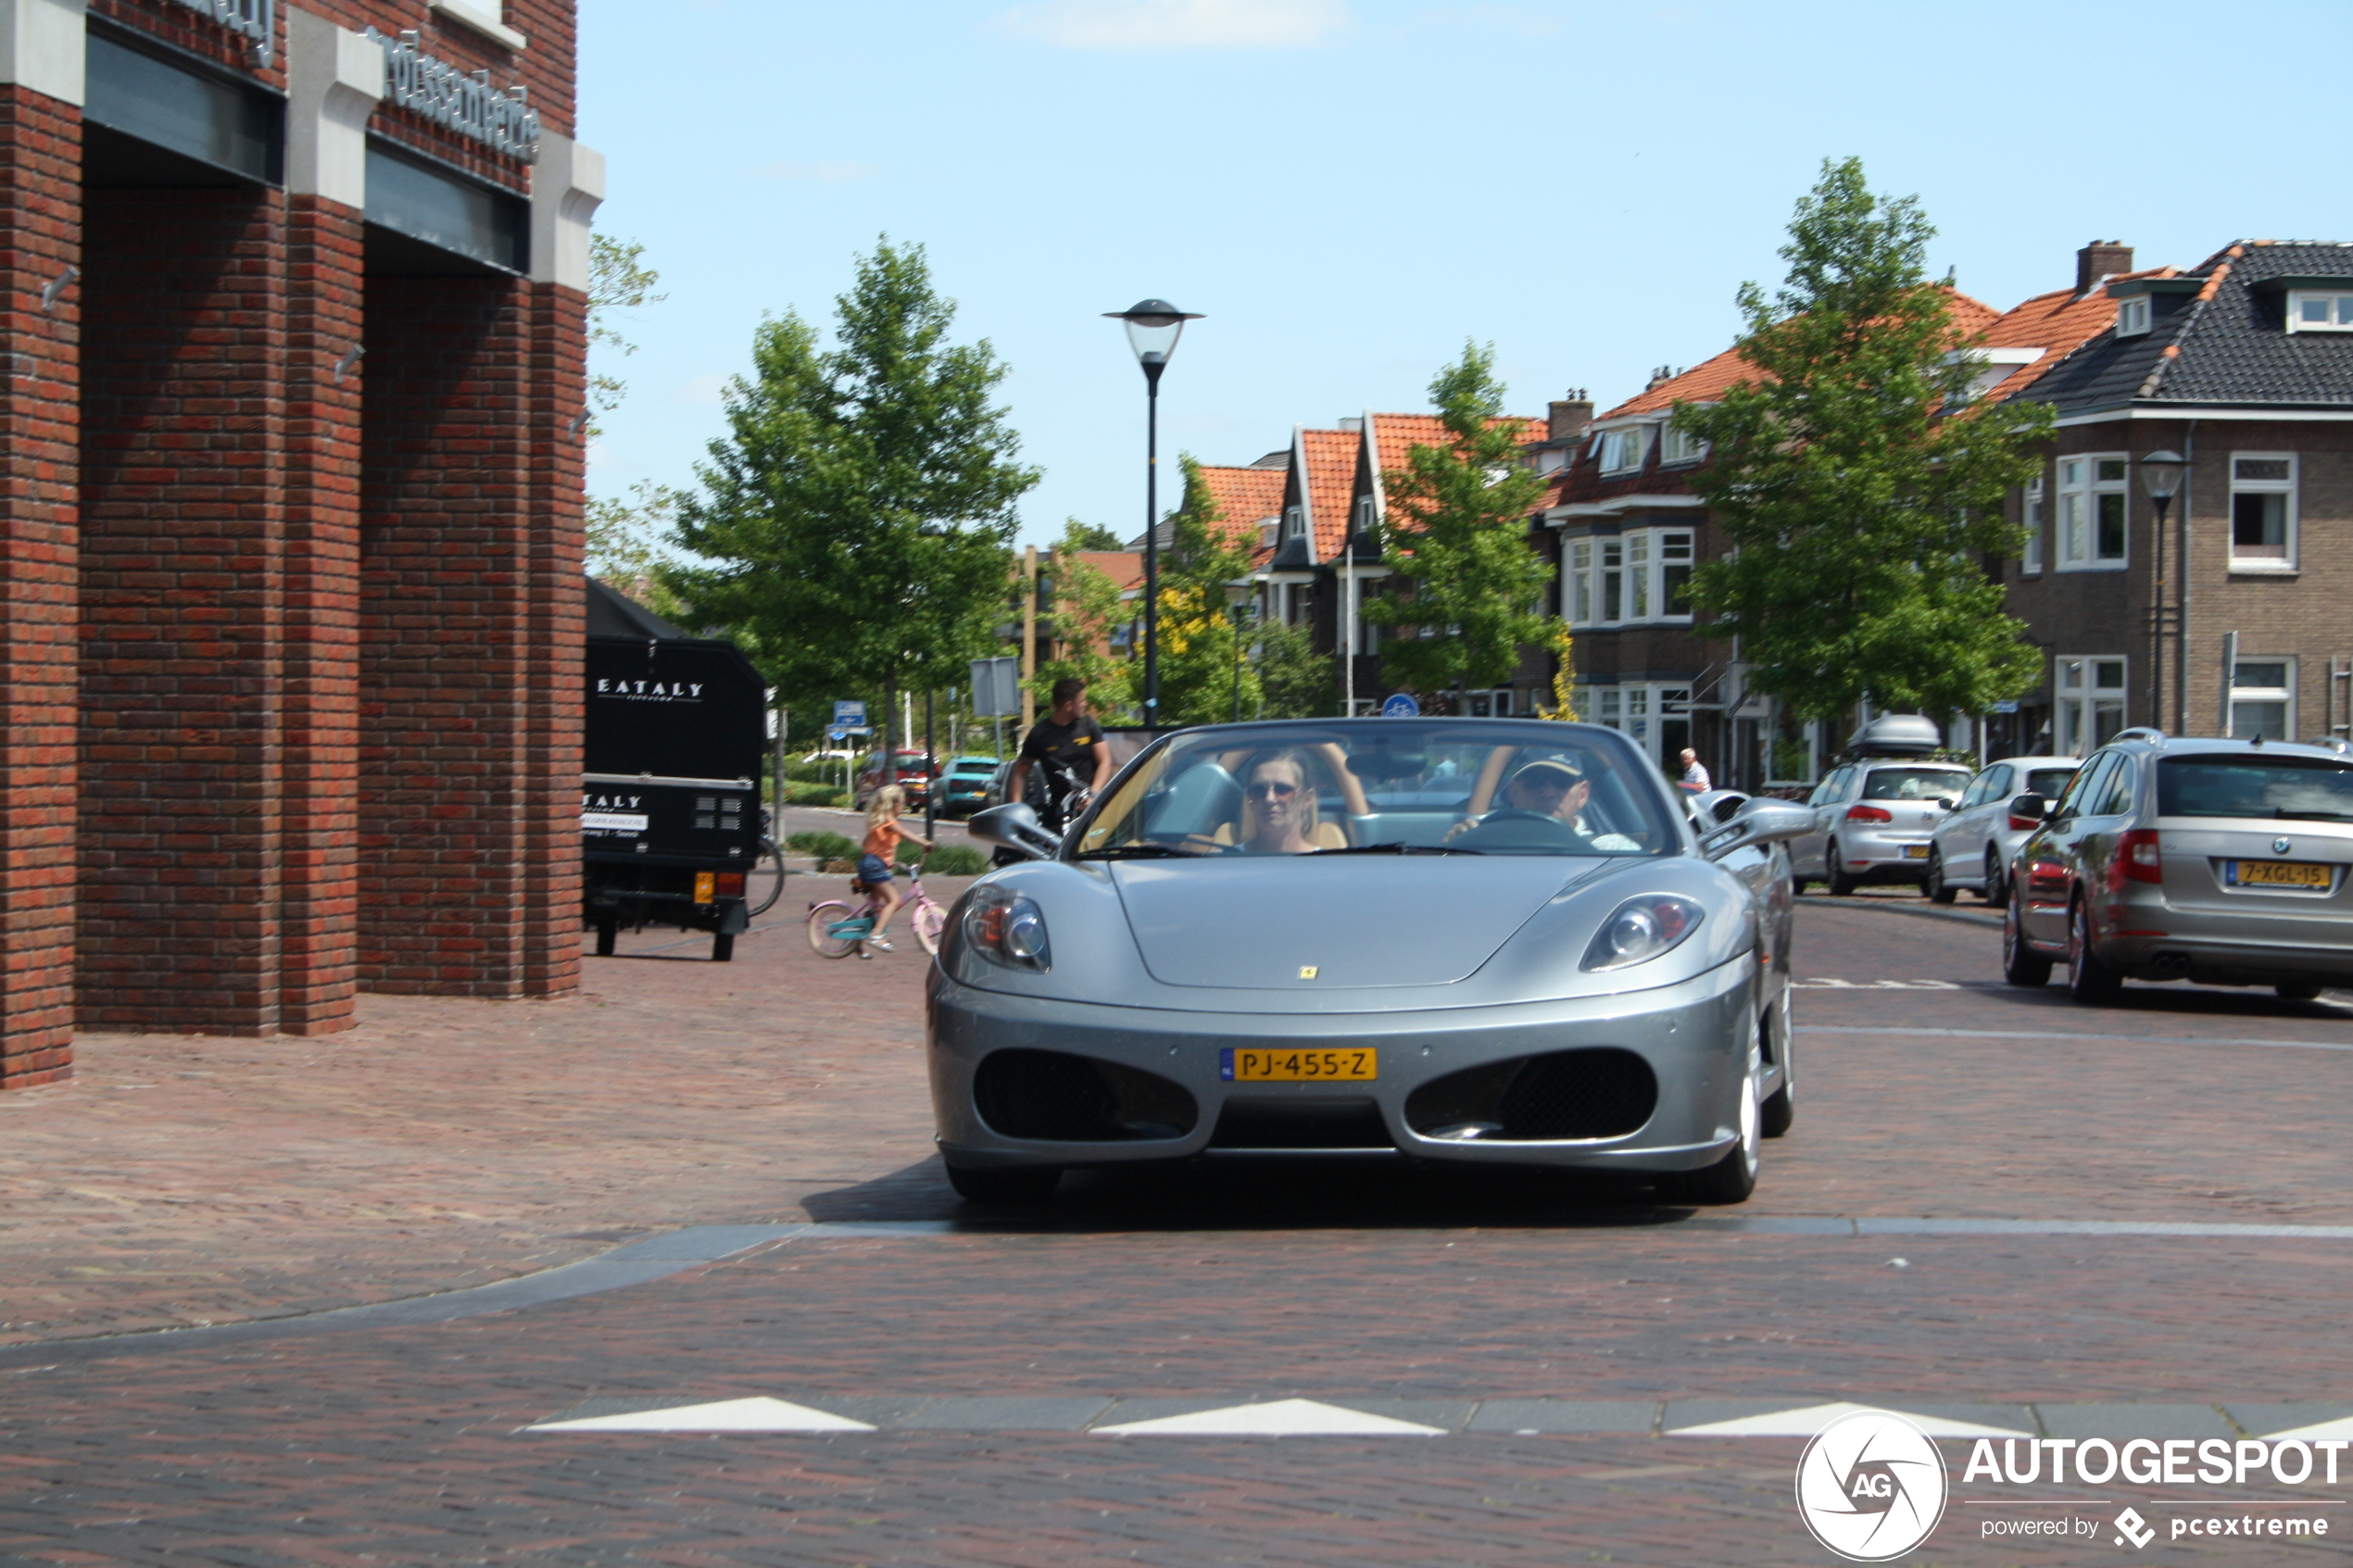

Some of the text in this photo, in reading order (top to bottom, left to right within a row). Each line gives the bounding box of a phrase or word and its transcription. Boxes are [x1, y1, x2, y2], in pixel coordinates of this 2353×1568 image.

[598, 678, 703, 697] EATALY
[582, 794, 641, 809] TALY
[2245, 863, 2322, 883] 7-XGL-15
[1243, 1053, 1366, 1075] PJ-455-Z
